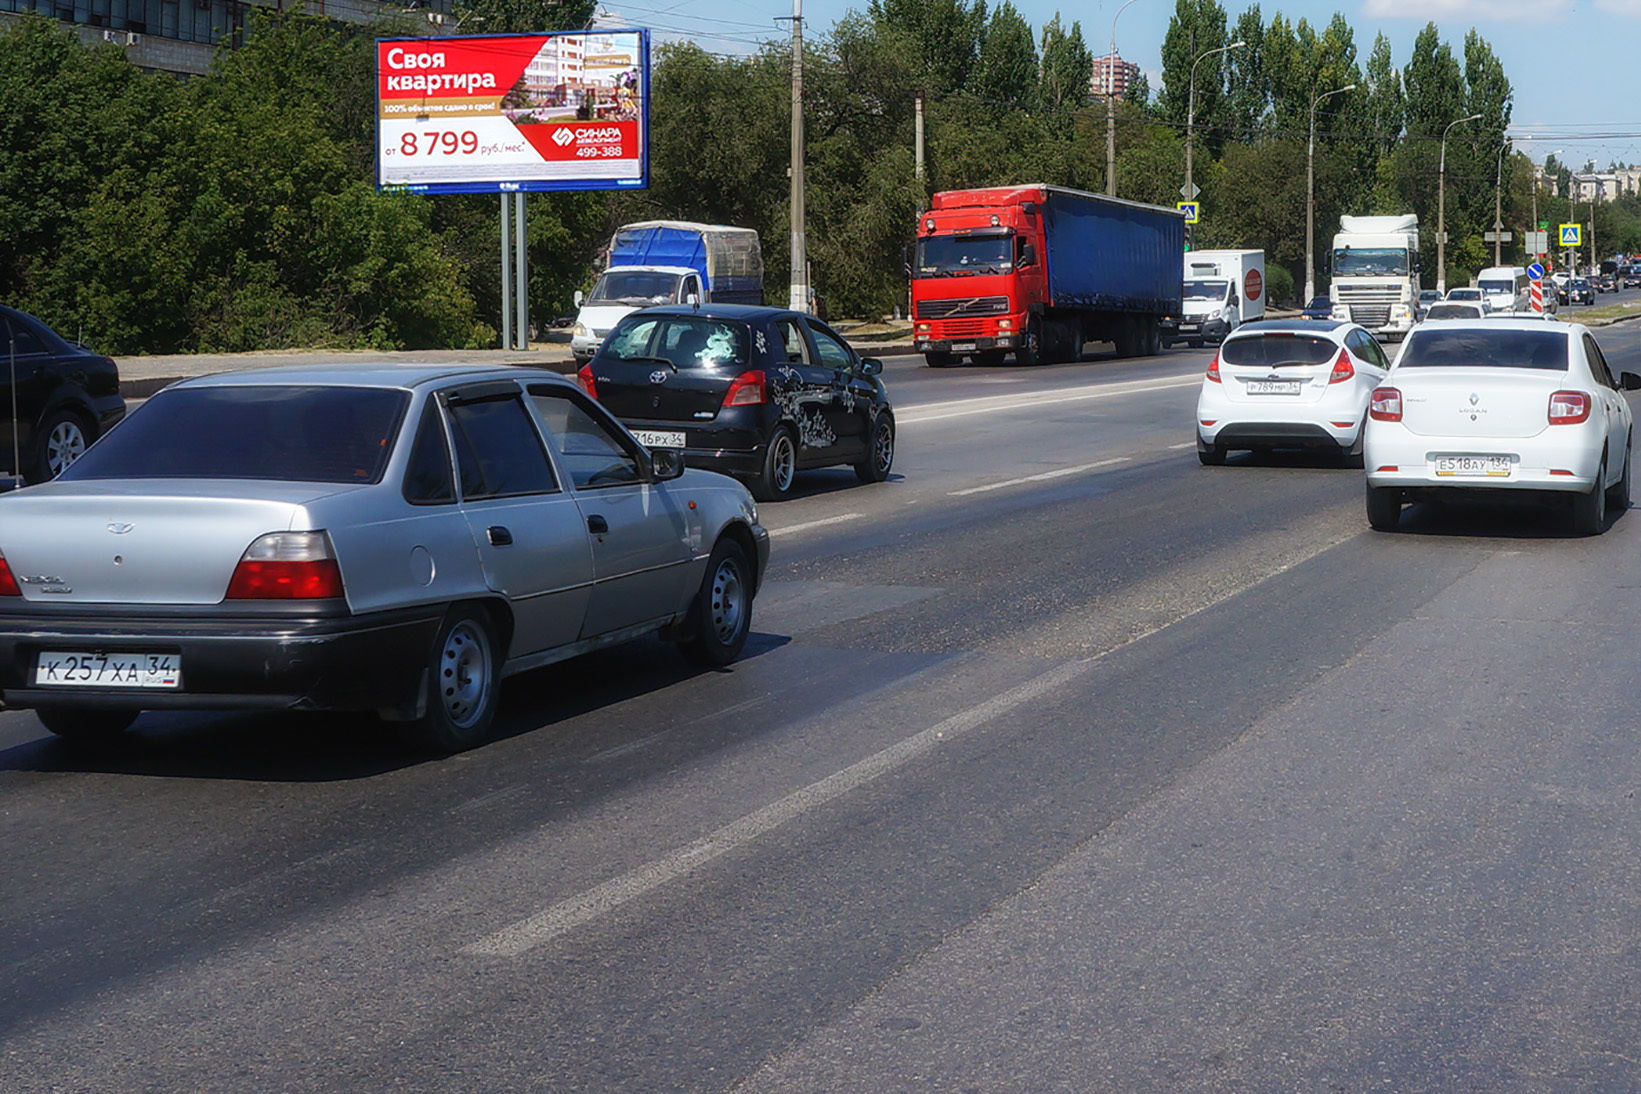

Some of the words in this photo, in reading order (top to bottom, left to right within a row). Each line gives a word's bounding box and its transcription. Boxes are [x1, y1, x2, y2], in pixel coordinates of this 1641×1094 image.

[387, 48, 445, 69] Своя
[387, 72, 496, 95] квартира
[384, 104, 407, 113] 100%
[575, 127, 622, 138] СИНАРА
[385, 148, 396, 156] от
[576, 146, 622, 157] 499-388
[147, 657, 171, 676] 34
